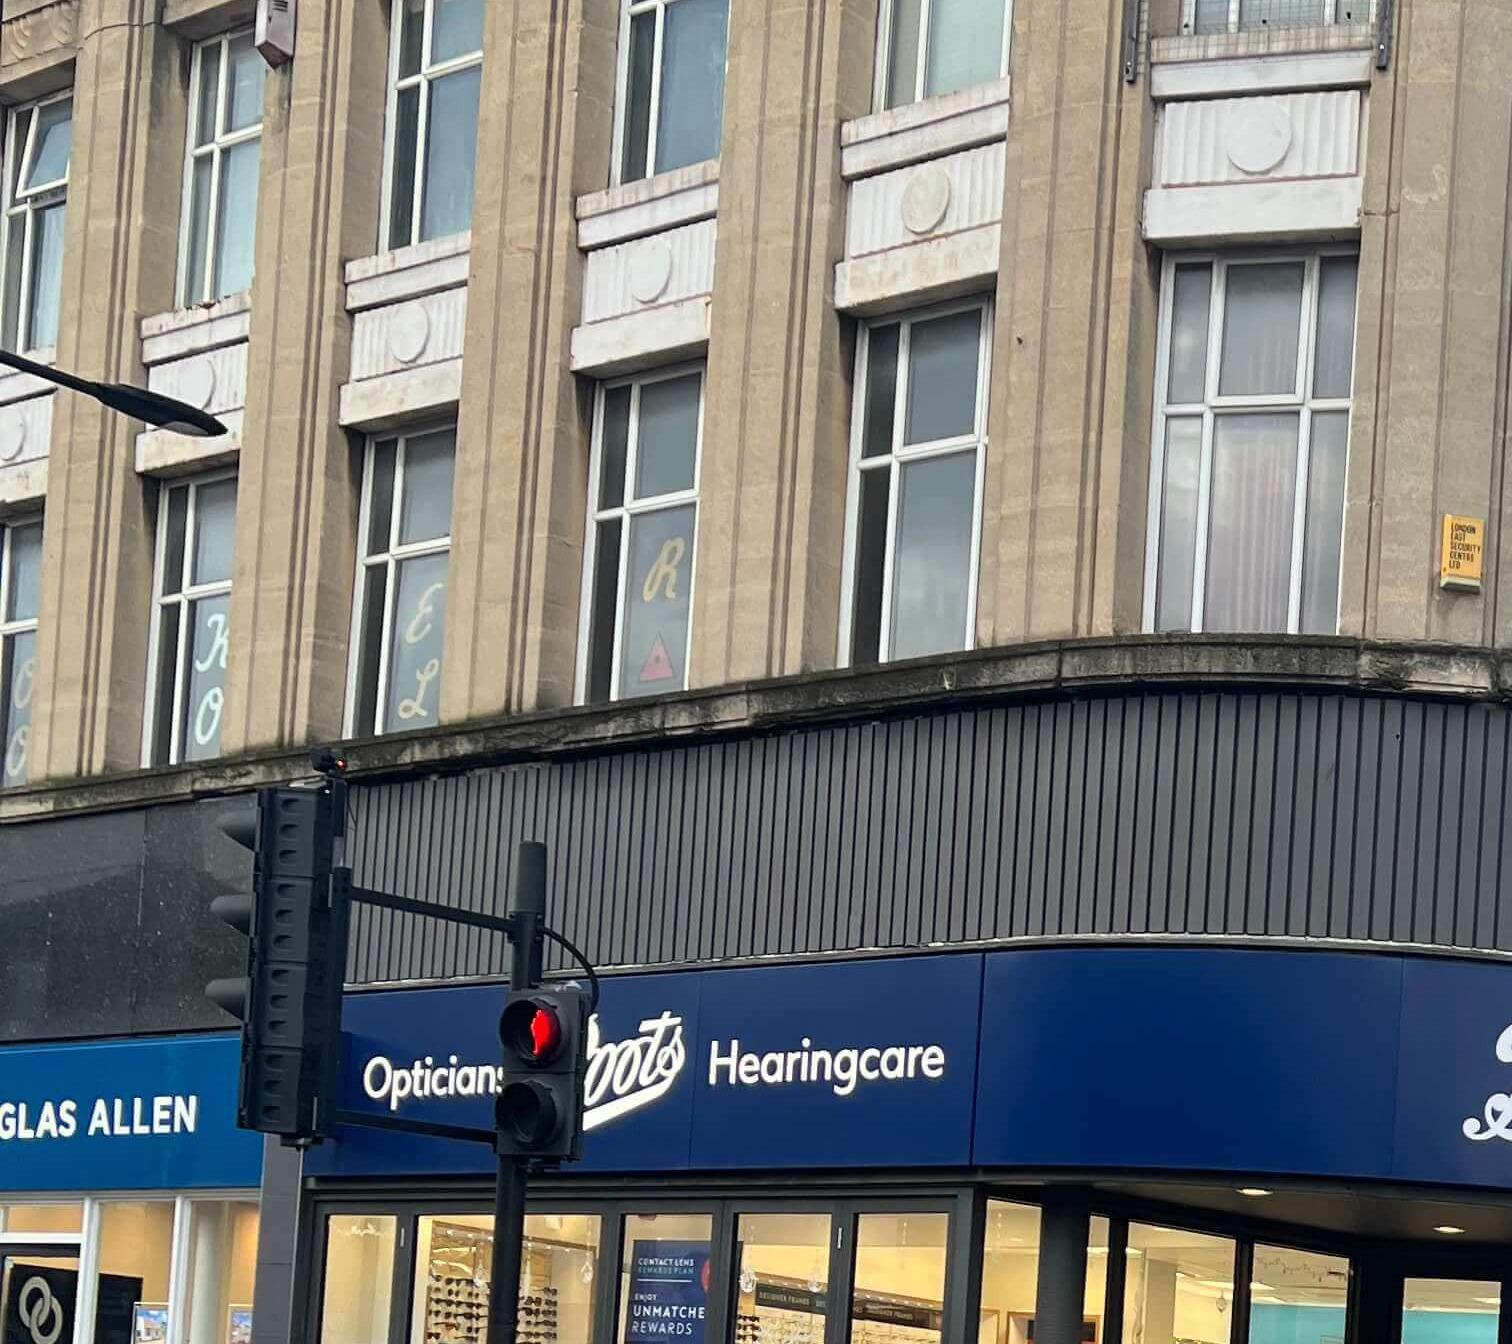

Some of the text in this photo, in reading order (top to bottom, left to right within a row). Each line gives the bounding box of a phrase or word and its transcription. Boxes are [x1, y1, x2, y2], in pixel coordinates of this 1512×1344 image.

[582, 1010, 686, 1131] oots
[708, 1037, 945, 1096] Hearingcare
[87, 1094, 198, 1136] ALLEN
[638, 1258, 694, 1267] CONTACT LENS
[635, 1292, 657, 1302] ENJOY
[633, 1305, 705, 1319] UNMATCHE
[631, 1321, 693, 1335] REWARDS
